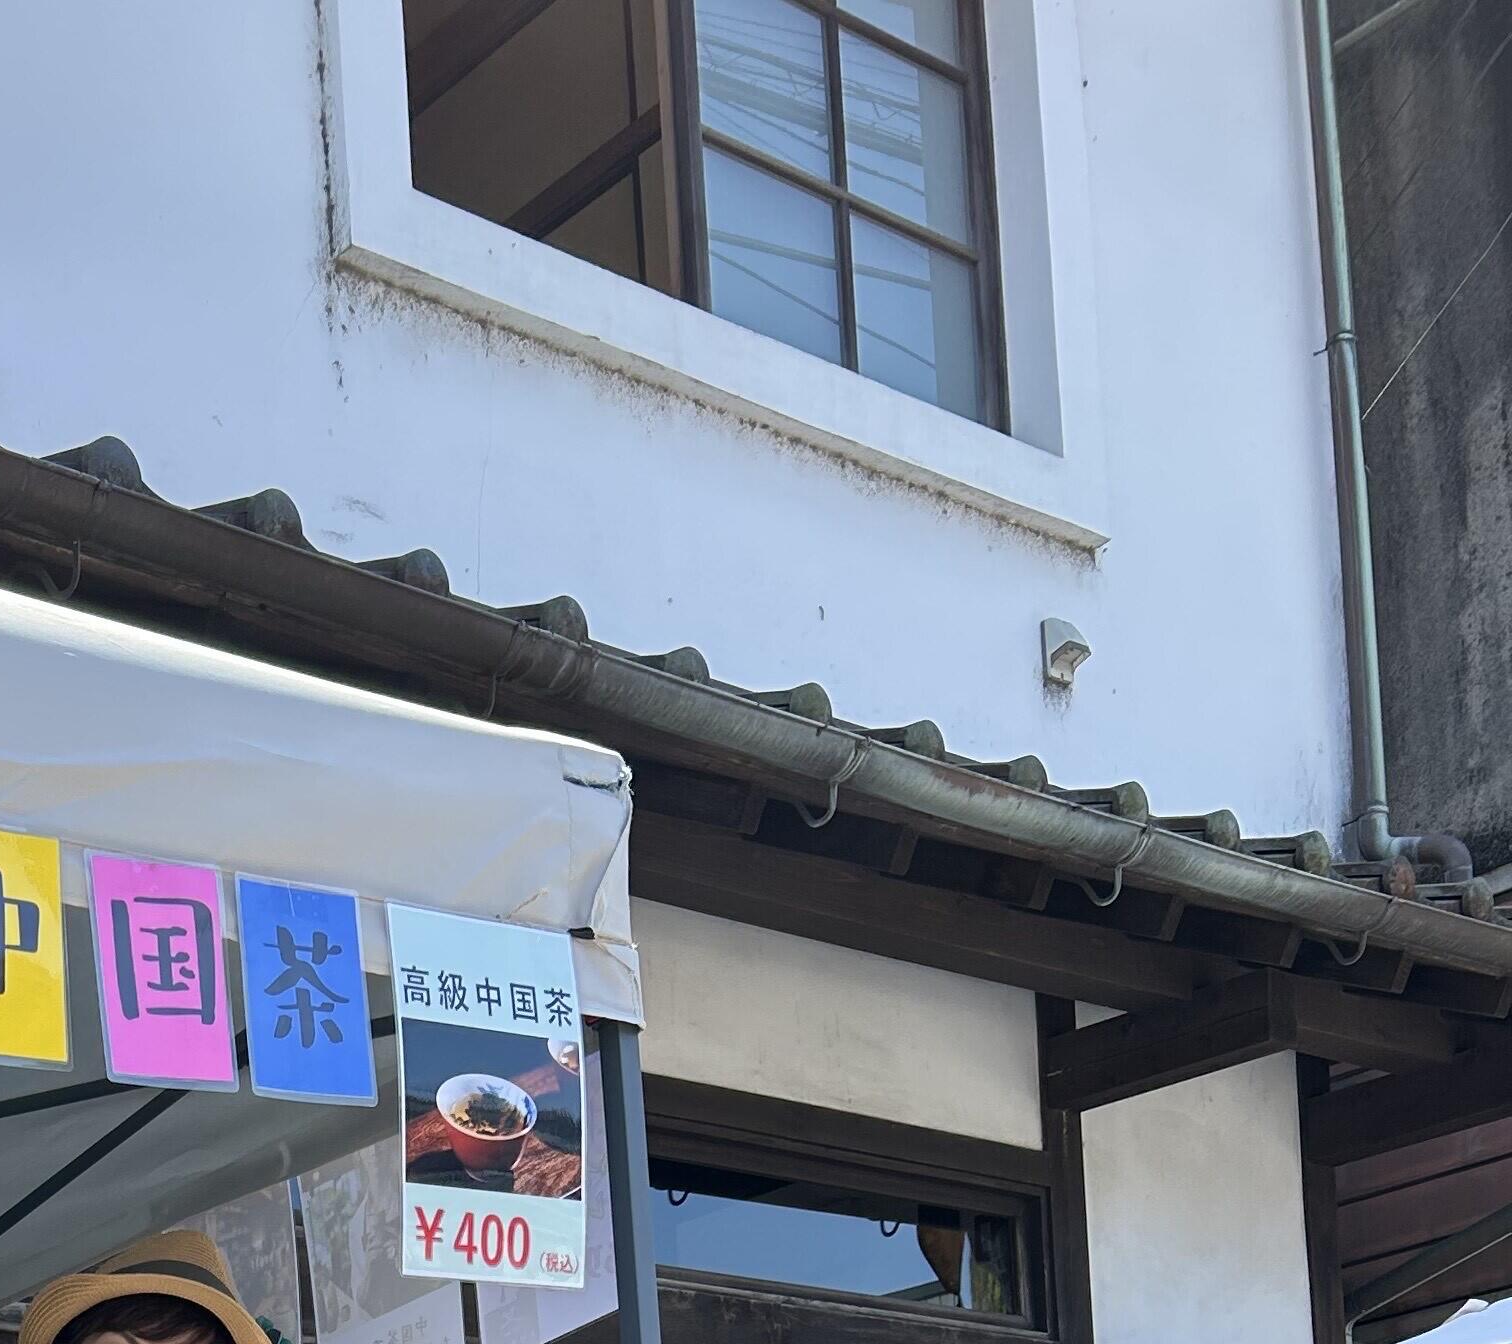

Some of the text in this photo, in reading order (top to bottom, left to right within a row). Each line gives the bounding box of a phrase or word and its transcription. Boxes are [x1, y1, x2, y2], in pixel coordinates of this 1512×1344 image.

[399, 964, 575, 1029] 高級中国茶
[414, 1205, 532, 1270] ¥400
